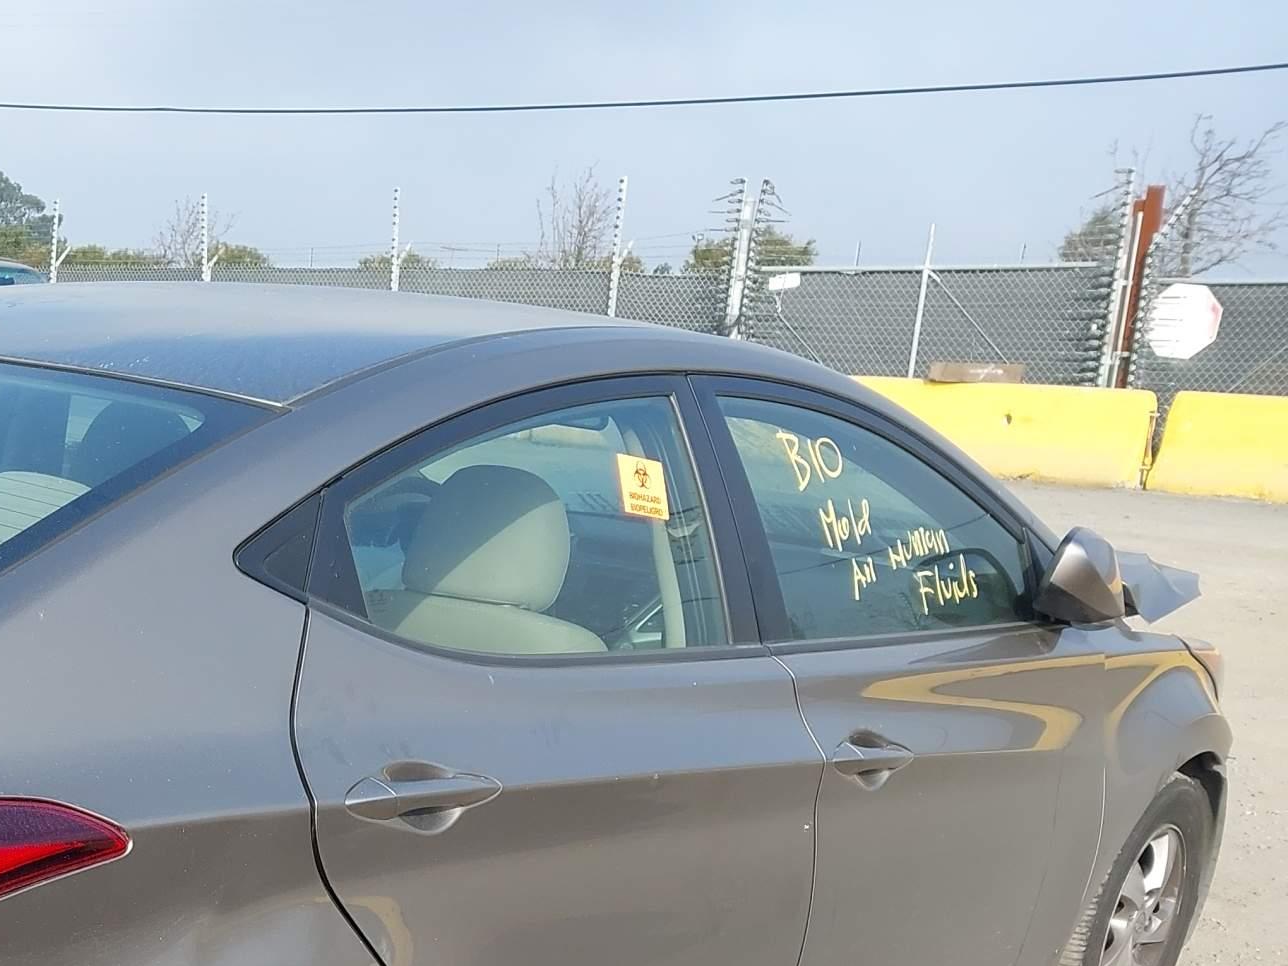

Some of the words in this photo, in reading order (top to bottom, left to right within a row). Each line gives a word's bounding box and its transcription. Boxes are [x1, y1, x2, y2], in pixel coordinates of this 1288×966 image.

[776, 429, 843, 492] BIO
[630, 492, 662, 504] BIOHAZARD
[819, 498, 872, 552] Mold
